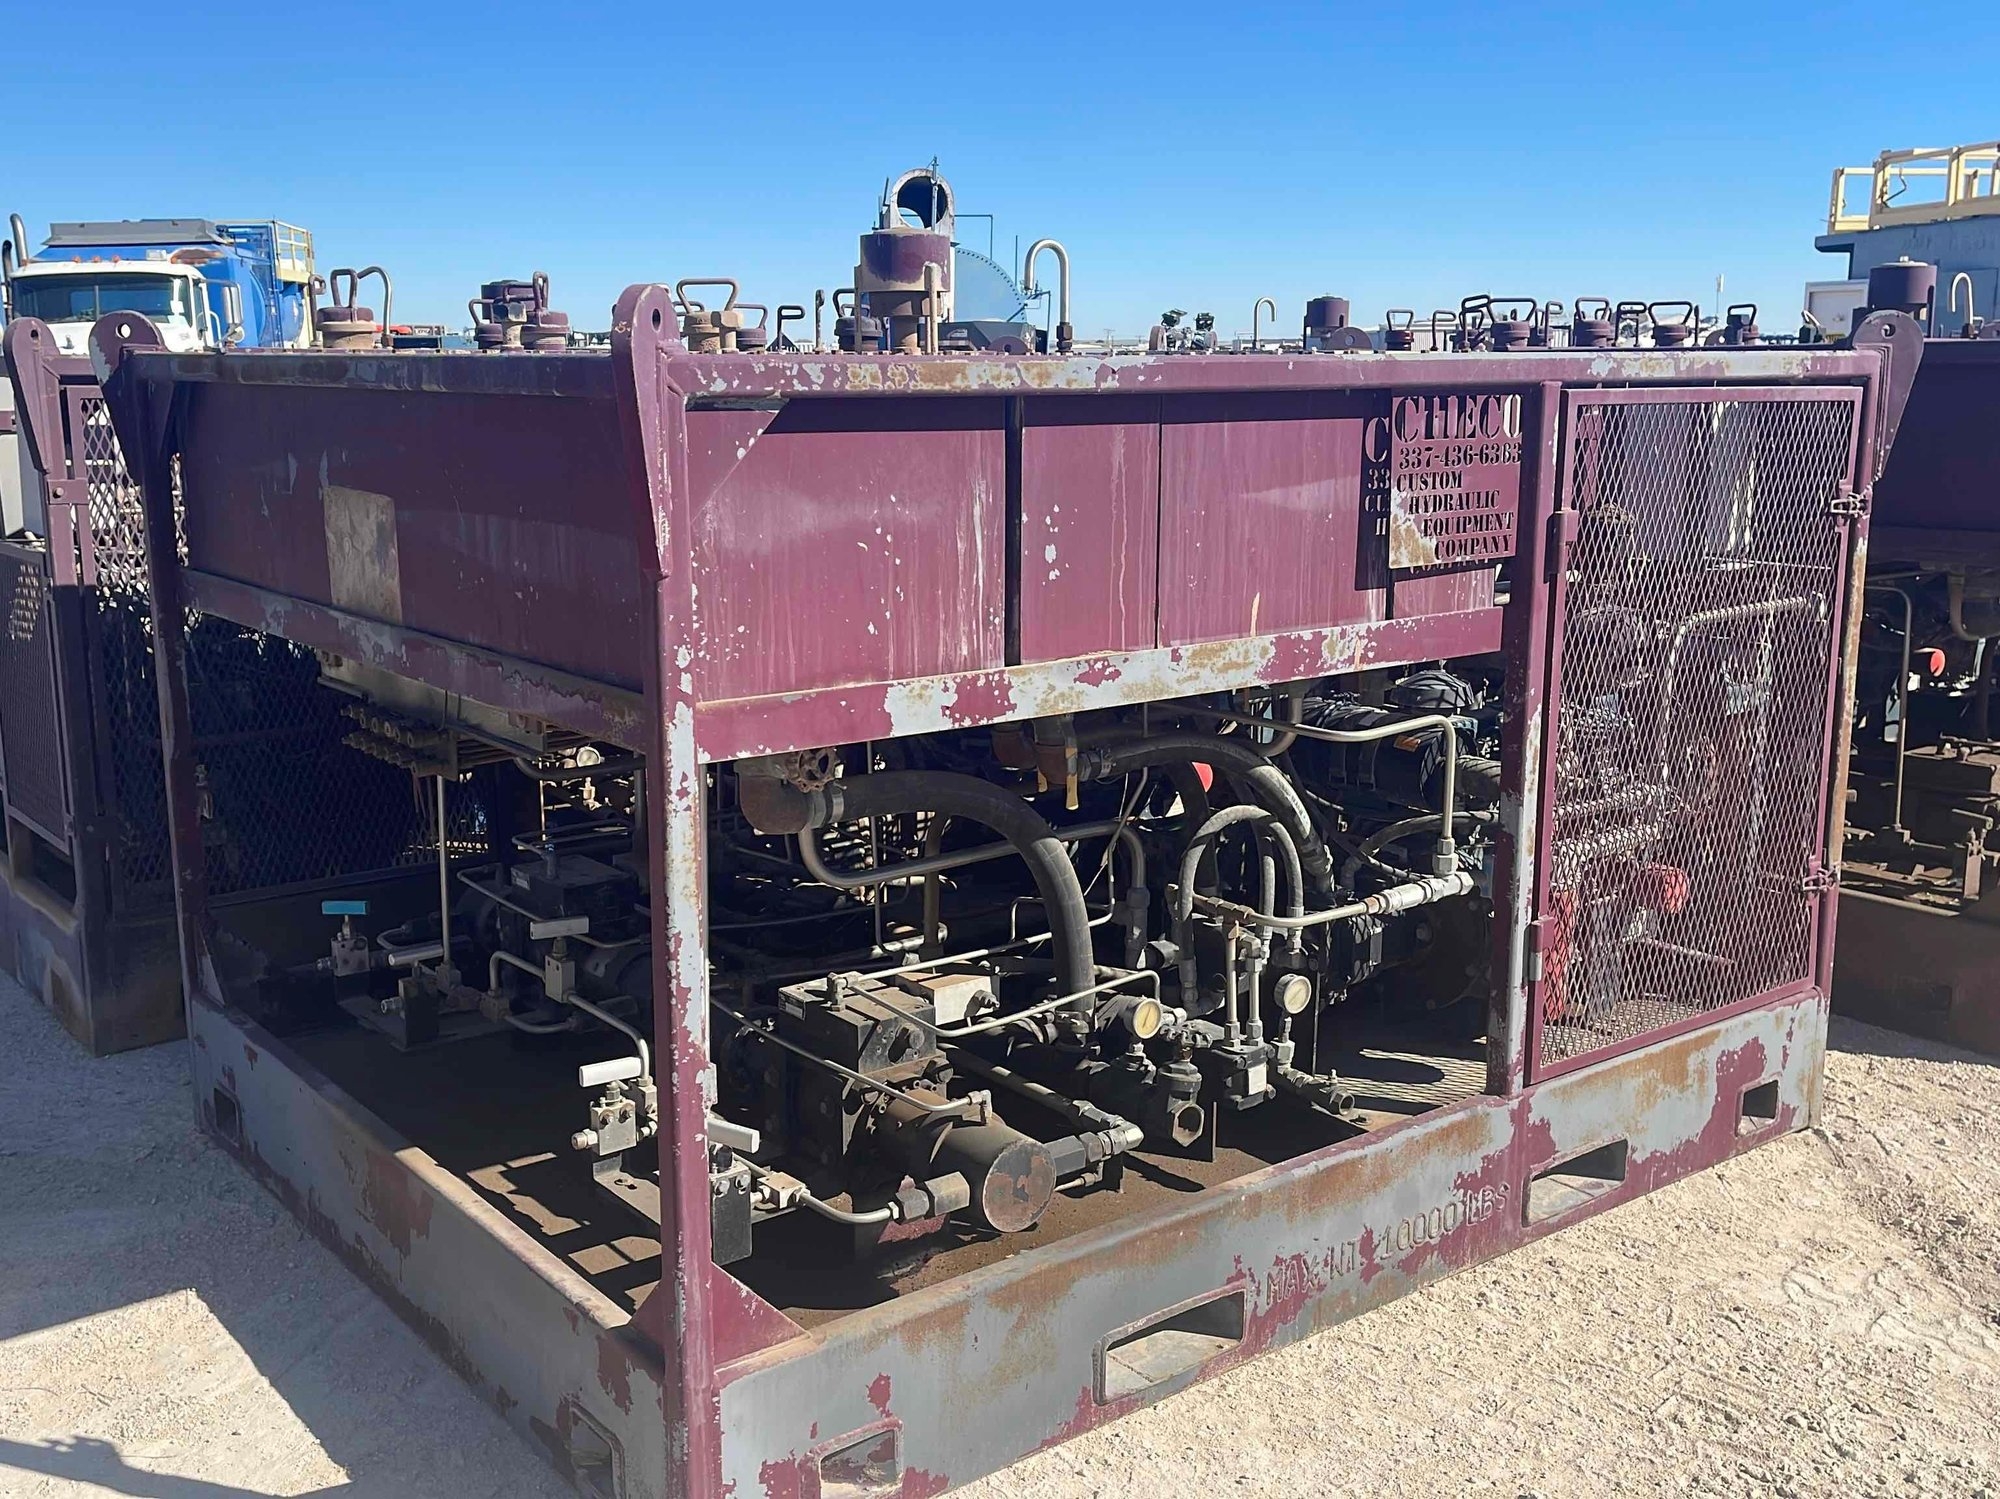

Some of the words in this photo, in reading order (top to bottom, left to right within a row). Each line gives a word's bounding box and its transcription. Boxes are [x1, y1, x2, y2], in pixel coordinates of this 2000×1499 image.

[1394, 394, 1522, 442] CHECO
[1396, 470, 1463, 493] CUSTOM
[1408, 490, 1500, 515] HYDRAULIC
[1423, 512, 1514, 537] EQUIPMENT
[1434, 534, 1512, 561] COMPANY
